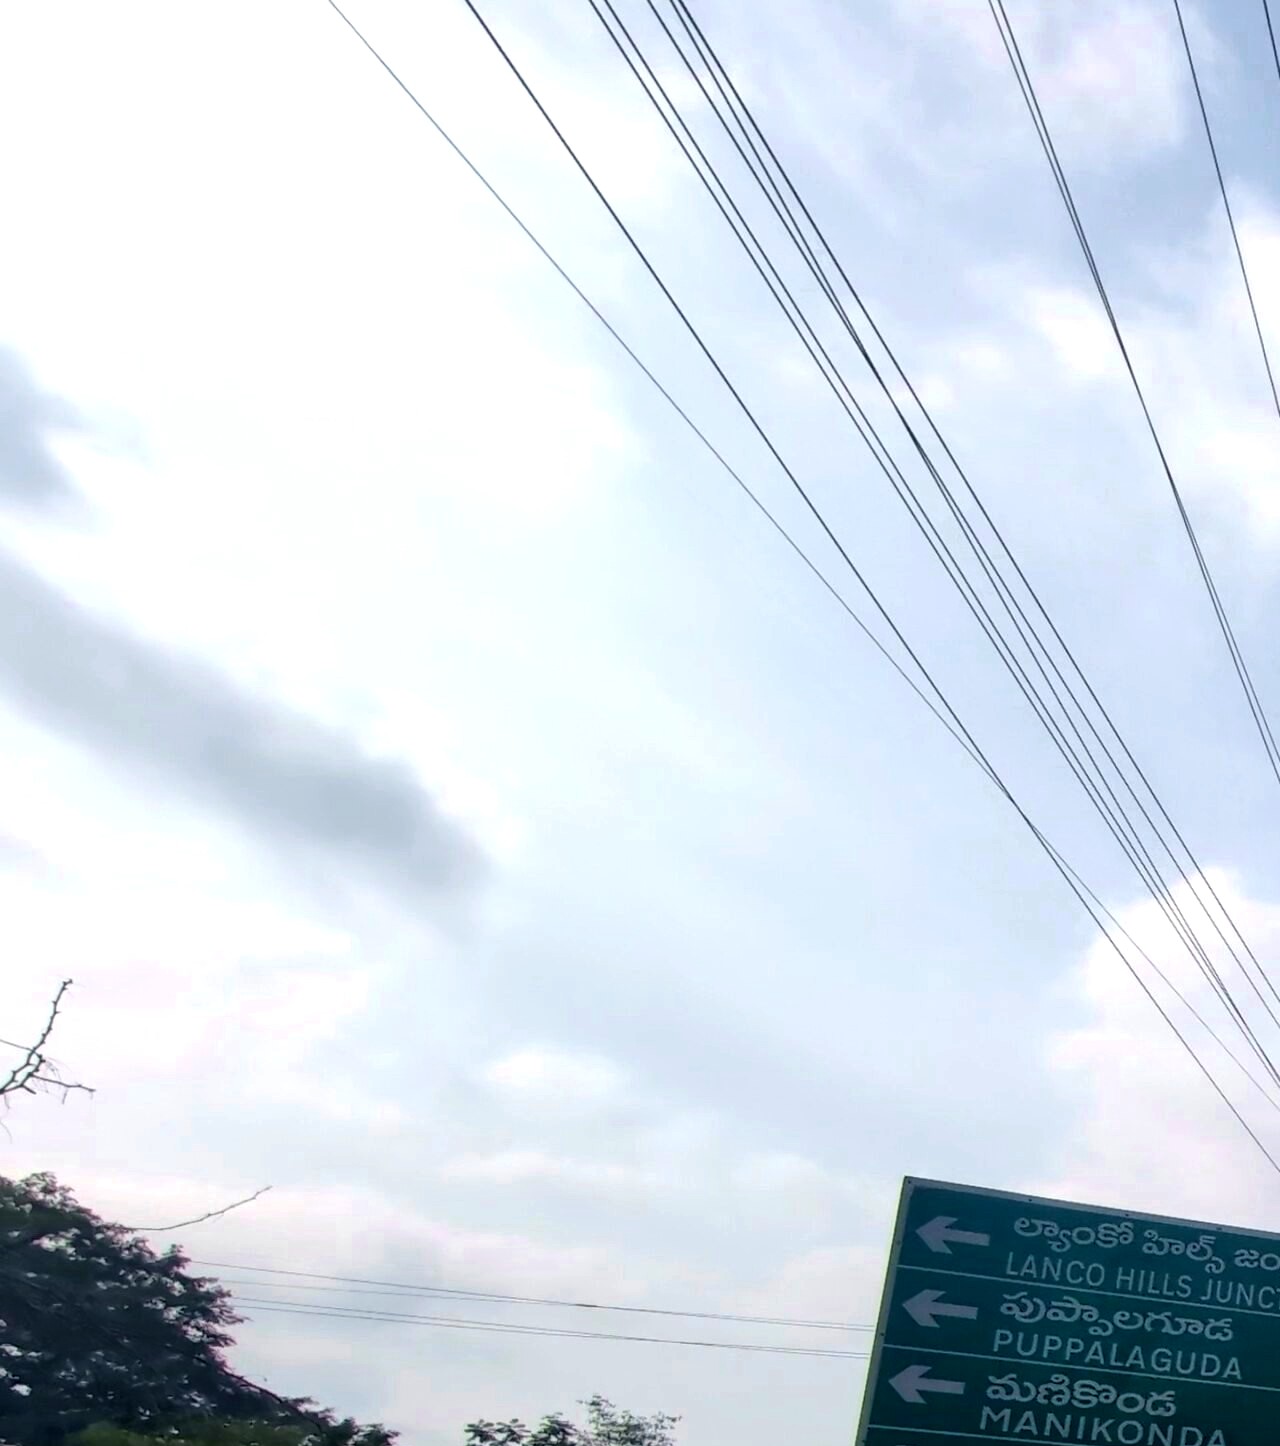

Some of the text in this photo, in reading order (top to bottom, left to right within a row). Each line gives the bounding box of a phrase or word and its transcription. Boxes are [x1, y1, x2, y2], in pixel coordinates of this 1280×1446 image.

[1005, 1251, 1106, 1287] LANCO
[1115, 1266, 1193, 1299] HILLS
[993, 1329, 1243, 1380] PUPPALAGUDA
